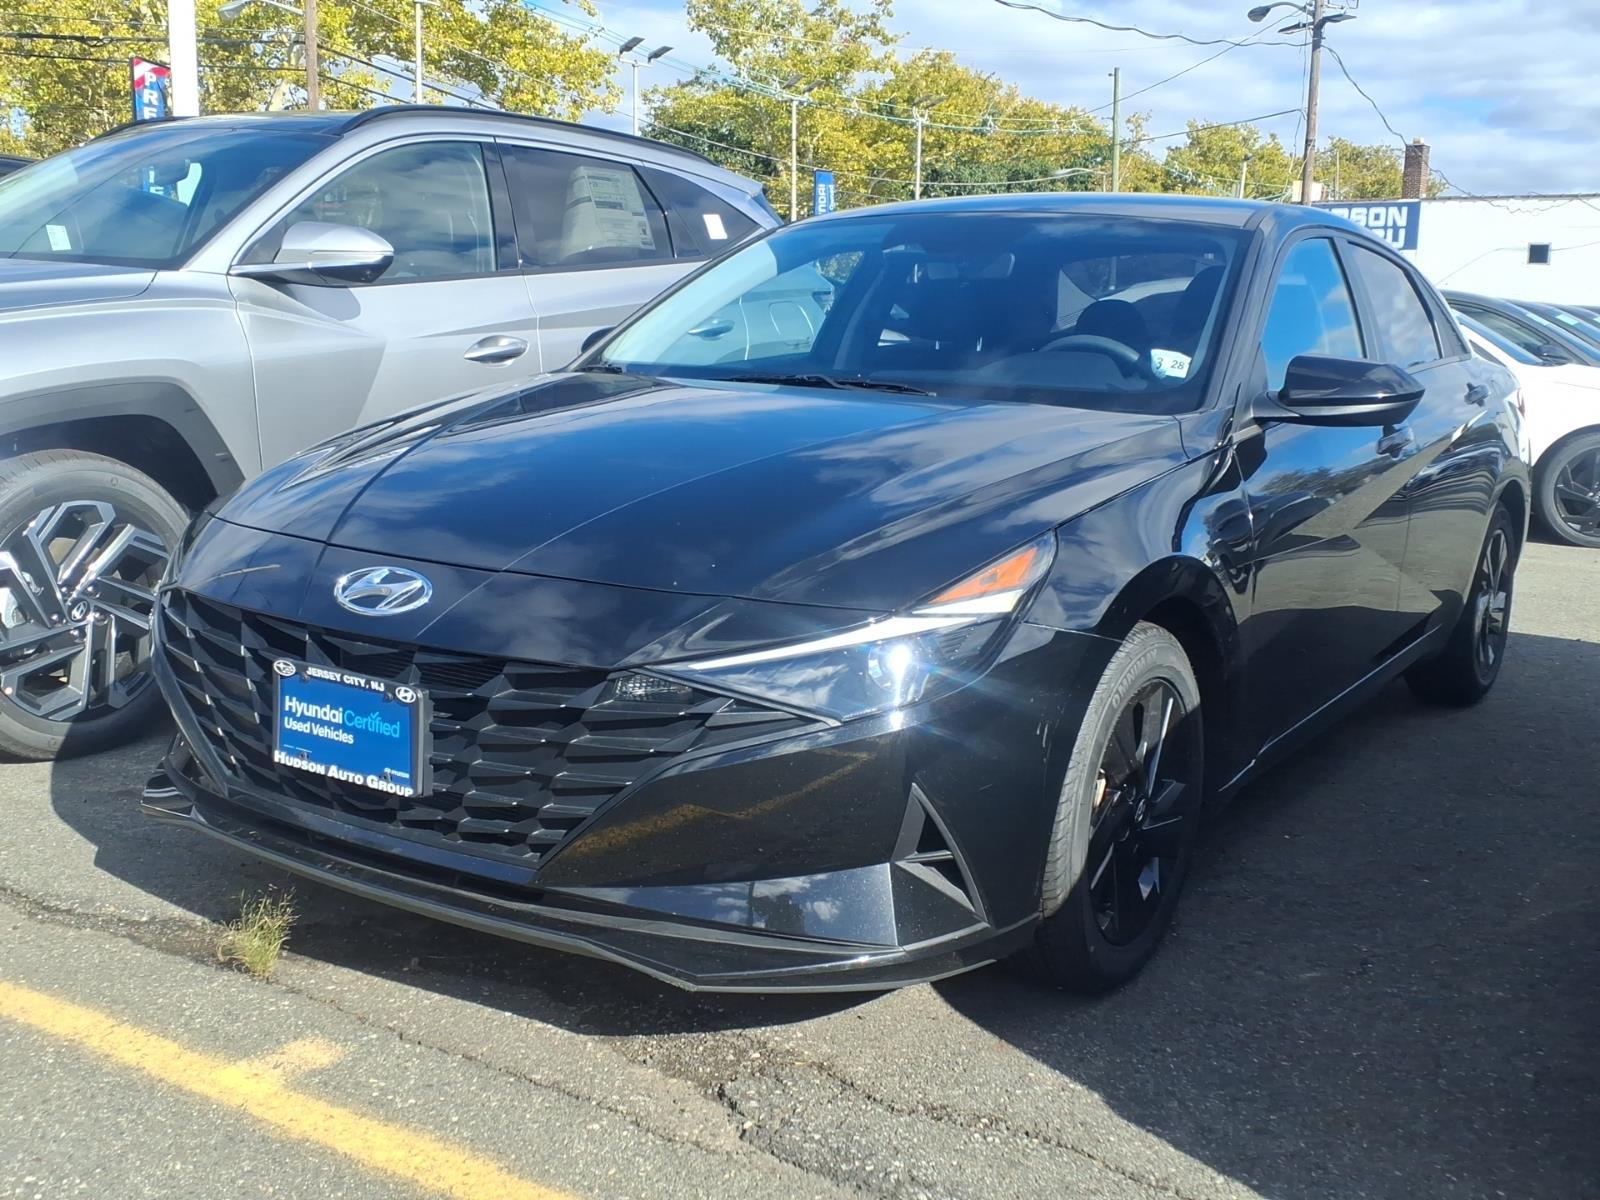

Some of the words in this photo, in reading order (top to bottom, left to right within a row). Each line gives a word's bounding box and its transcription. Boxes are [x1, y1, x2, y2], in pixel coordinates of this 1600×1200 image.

[818, 184, 827, 214] NDAI
[1155, 356, 1164, 370] 3
[1170, 359, 1185, 370] 28
[306, 667, 341, 682] JERSEY
[343, 674, 369, 689] CITY,
[371, 680, 385, 692] NJ
[284, 696, 343, 725] Hyundai
[344, 710, 400, 738] Certified
[284, 716, 310, 733] Used
[311, 722, 354, 744] Vehicles
